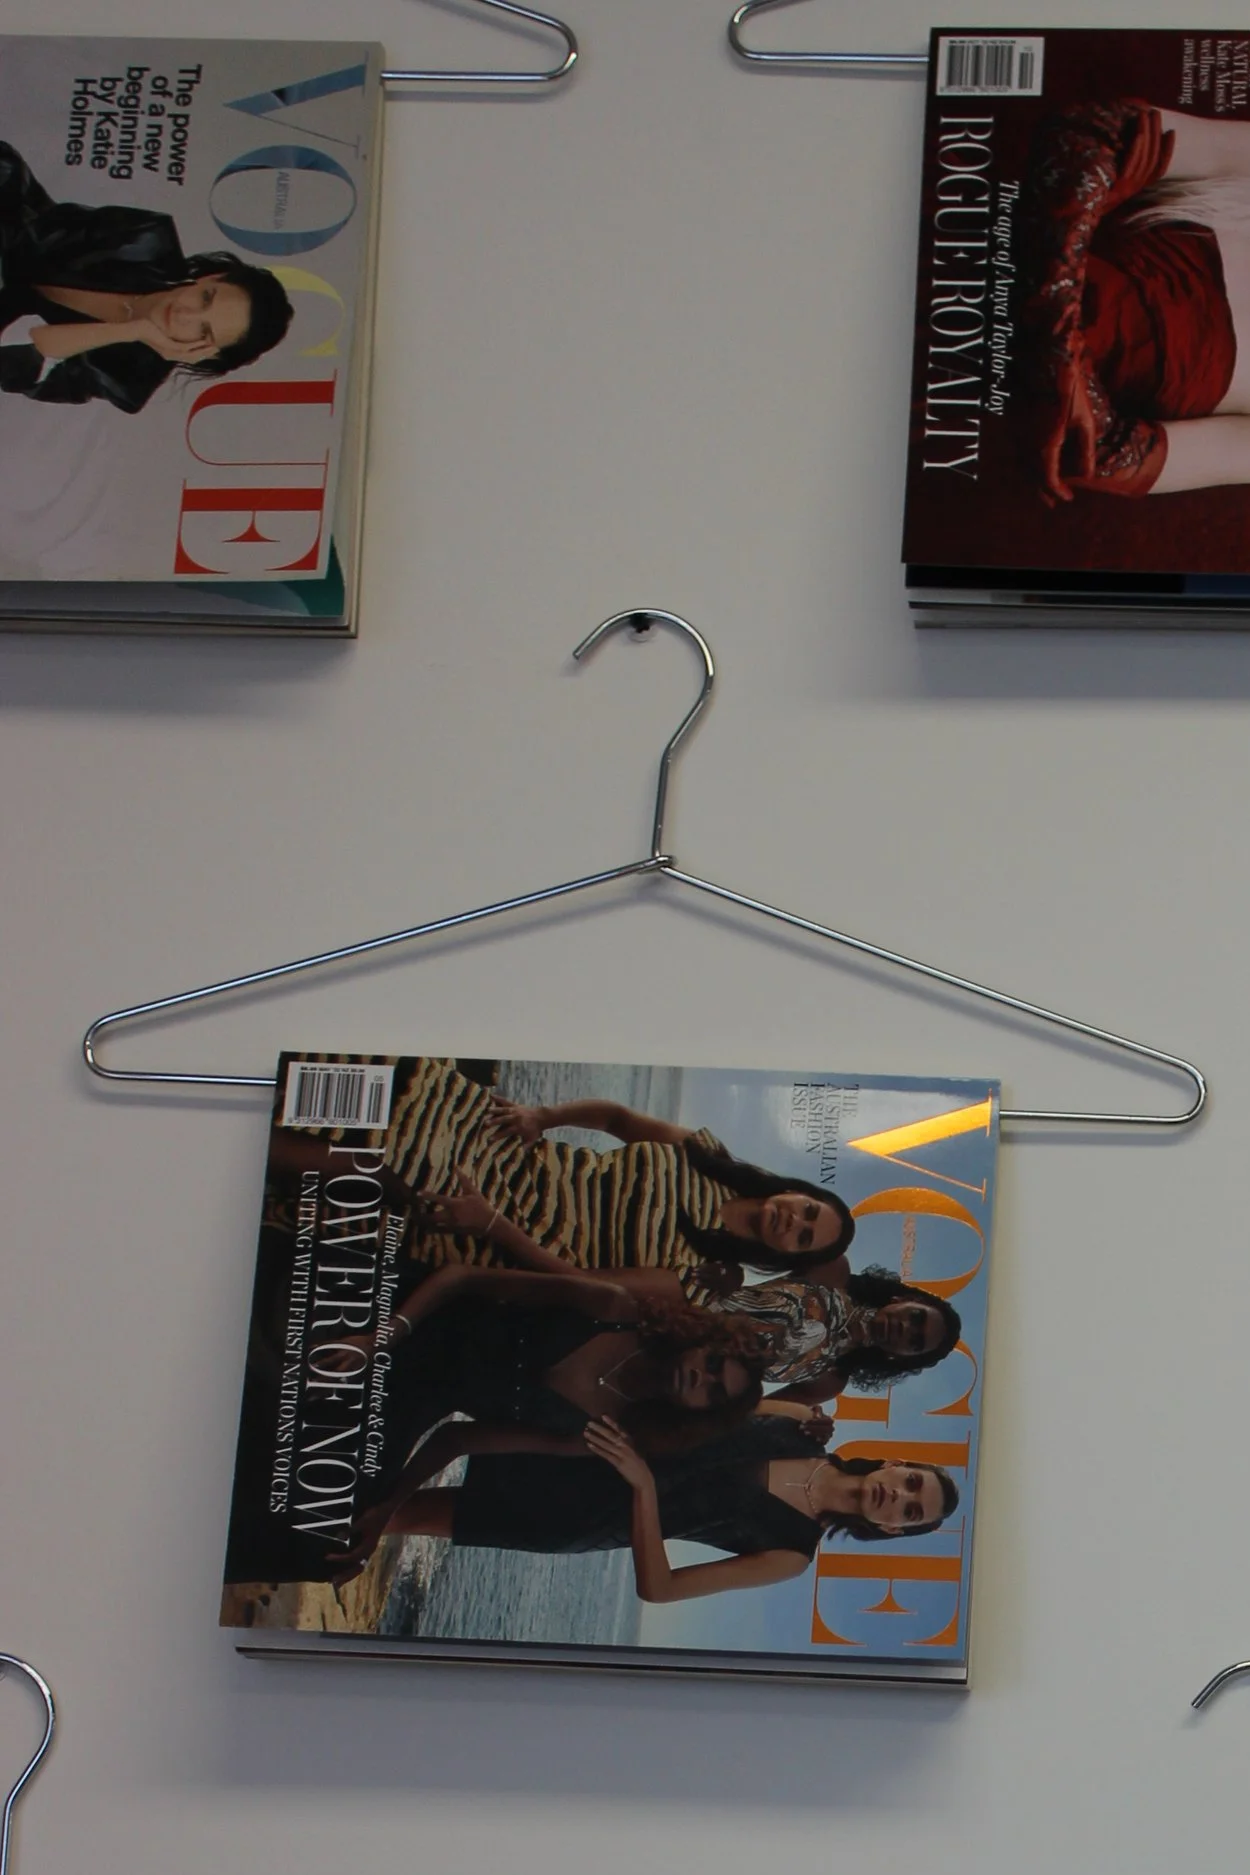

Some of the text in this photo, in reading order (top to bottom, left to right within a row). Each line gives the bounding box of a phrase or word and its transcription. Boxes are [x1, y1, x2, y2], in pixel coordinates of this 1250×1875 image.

[65, 79, 98, 166] Holmes
[91, 77, 123, 169] by Katie
[109, 66, 150, 179] beginning
[143, 76, 173, 172] of a new
[167, 64, 202, 186] The power
[1214, 40, 1232, 113] Kate Moss's
[1232, 40, 1249, 110] NATURAL
[933, 115, 995, 265] ROGUE
[984, 179, 1020, 416] The age of Anya Taylor-Joy
[922, 279, 987, 481] ROYALTY
[791, 1083, 809, 1129] ISSUE
[806, 1083, 825, 1153] FASHION
[820, 1083, 841, 1184] AUSTRALIAN
[842, 1084, 860, 1117] THE
[269, 1170, 320, 1513] UNITING WITH FIRST NATIONS VOICES
[290, 1142, 387, 1548] POWER OF NOW
[359, 1214, 405, 1477] Elaine, Magnolia, Charlee & Cindy
